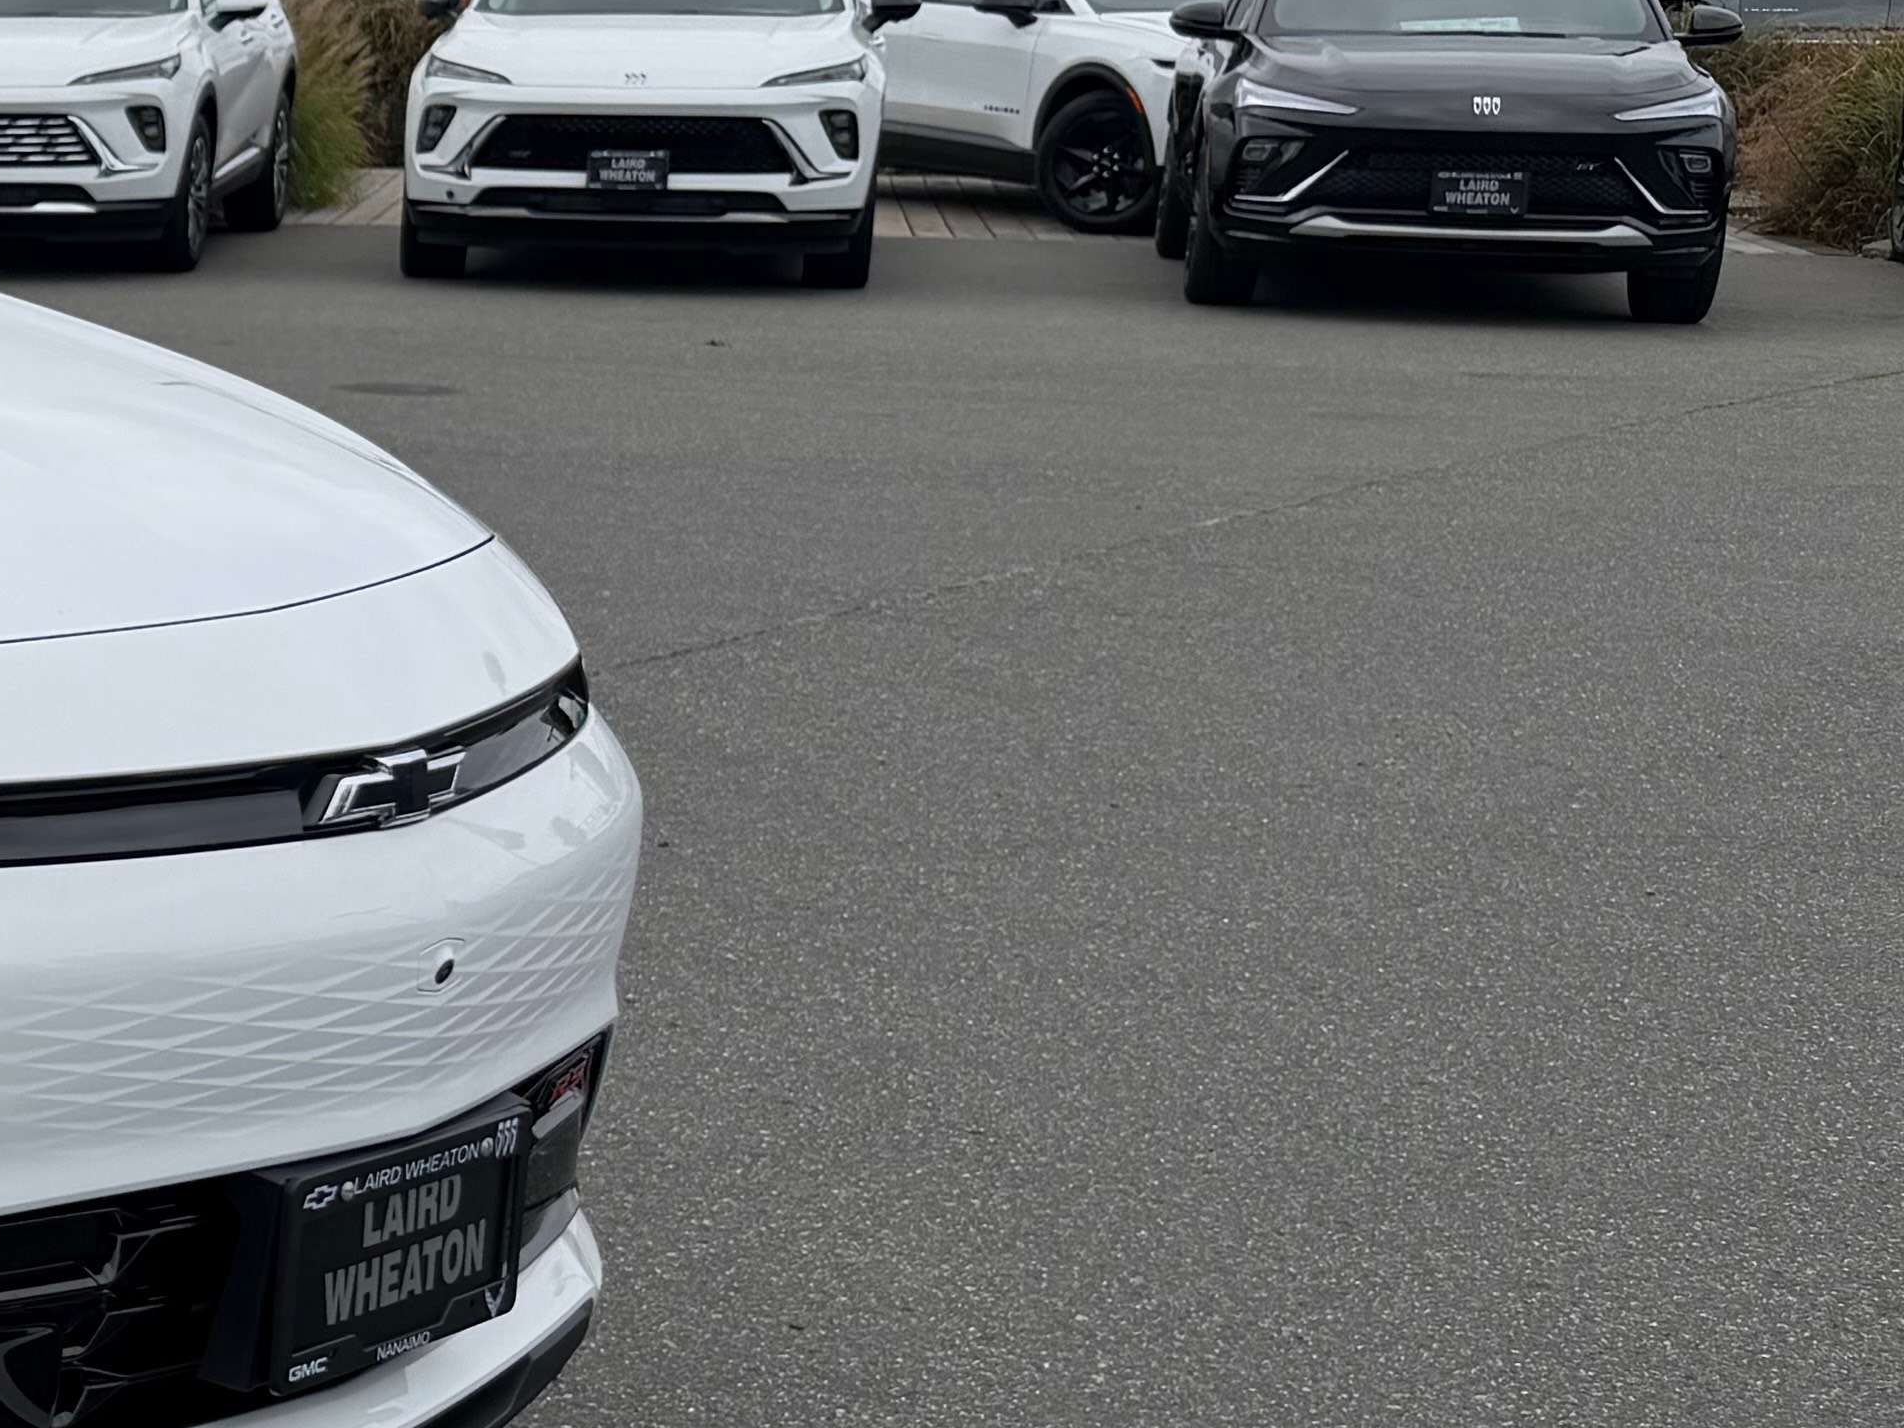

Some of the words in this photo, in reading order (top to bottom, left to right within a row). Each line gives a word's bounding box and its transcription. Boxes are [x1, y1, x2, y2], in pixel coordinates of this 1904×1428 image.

[1445, 191, 1510, 206] WHEATON
[353, 1165, 402, 1195] LAIRD
[404, 1143, 479, 1181] WHEATON
[362, 1174, 461, 1249] LAIRD
[324, 1218, 486, 1326] WHEATON
[376, 1330, 430, 1361] NANAIMO
[288, 1356, 329, 1382] GMC
